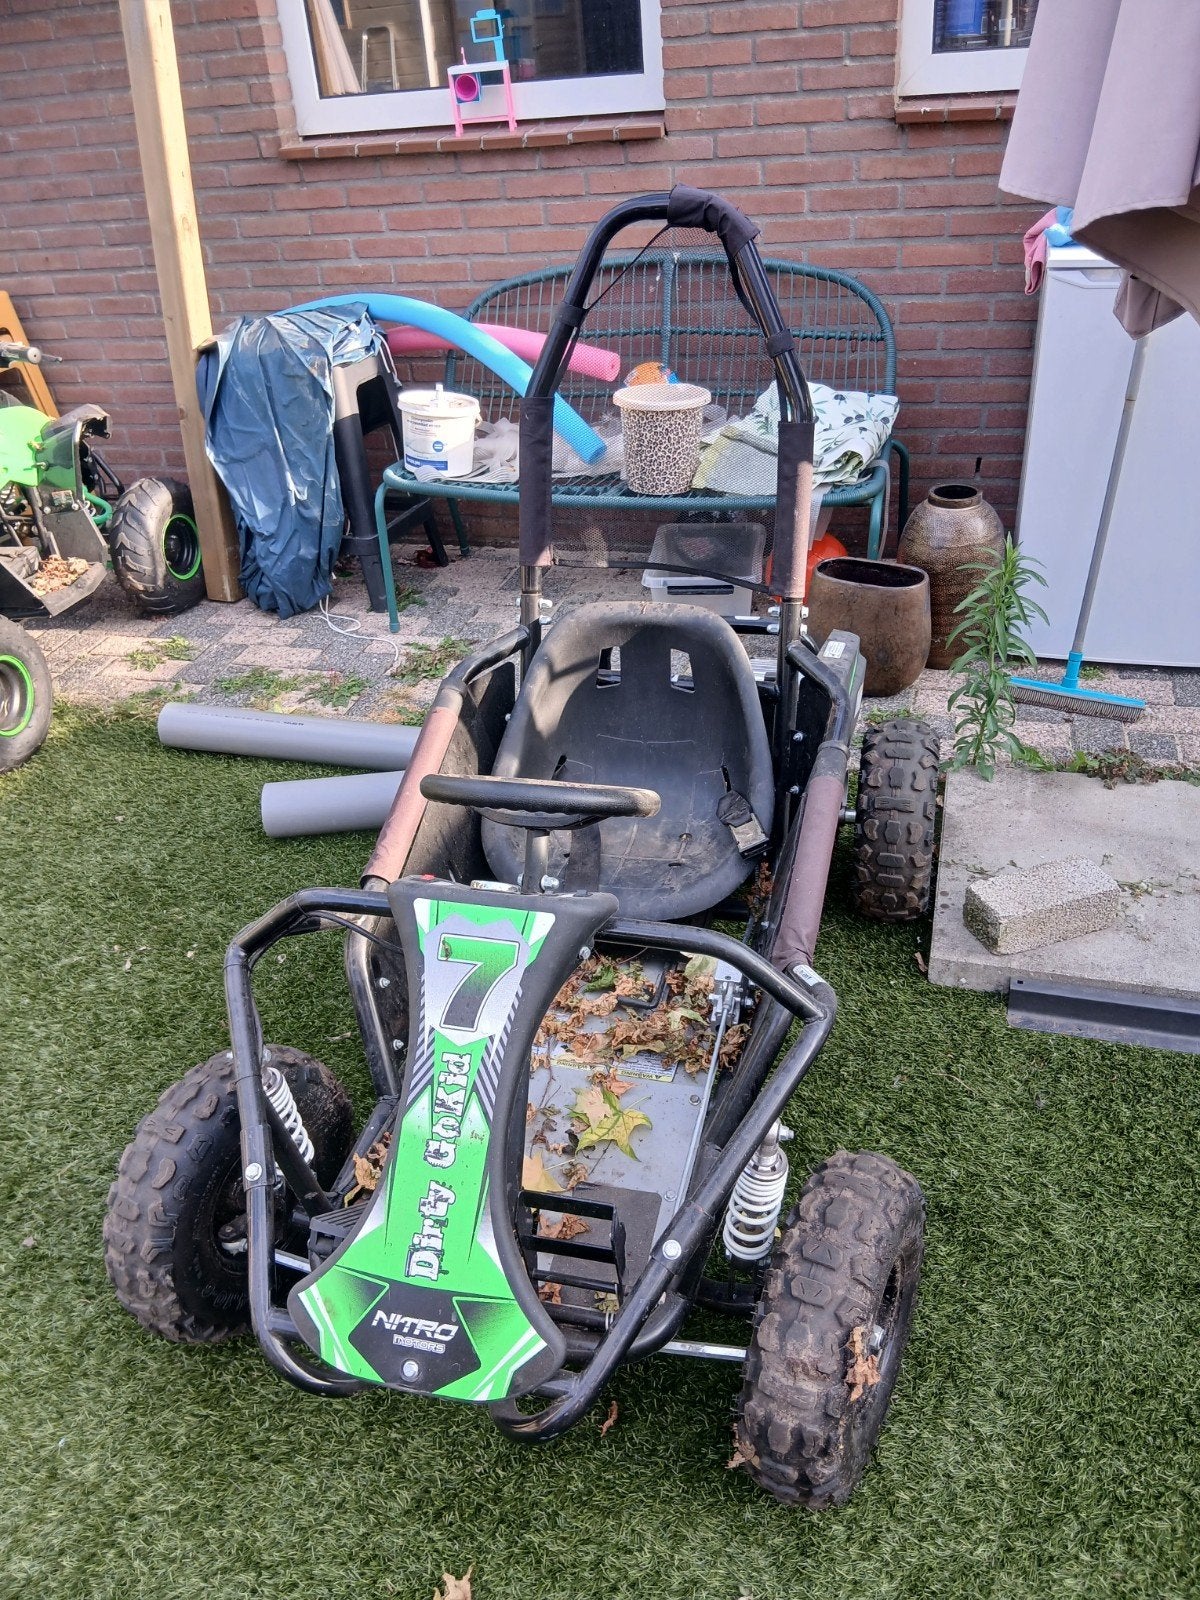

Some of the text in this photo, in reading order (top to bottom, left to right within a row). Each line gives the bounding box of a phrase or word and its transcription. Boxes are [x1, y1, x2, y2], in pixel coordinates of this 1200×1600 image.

[437, 932, 520, 1033] 7
[404, 1180, 456, 1282] Dirty
[371, 1309, 459, 1342] NITRO
[392, 1333, 446, 1354] MOTORS
